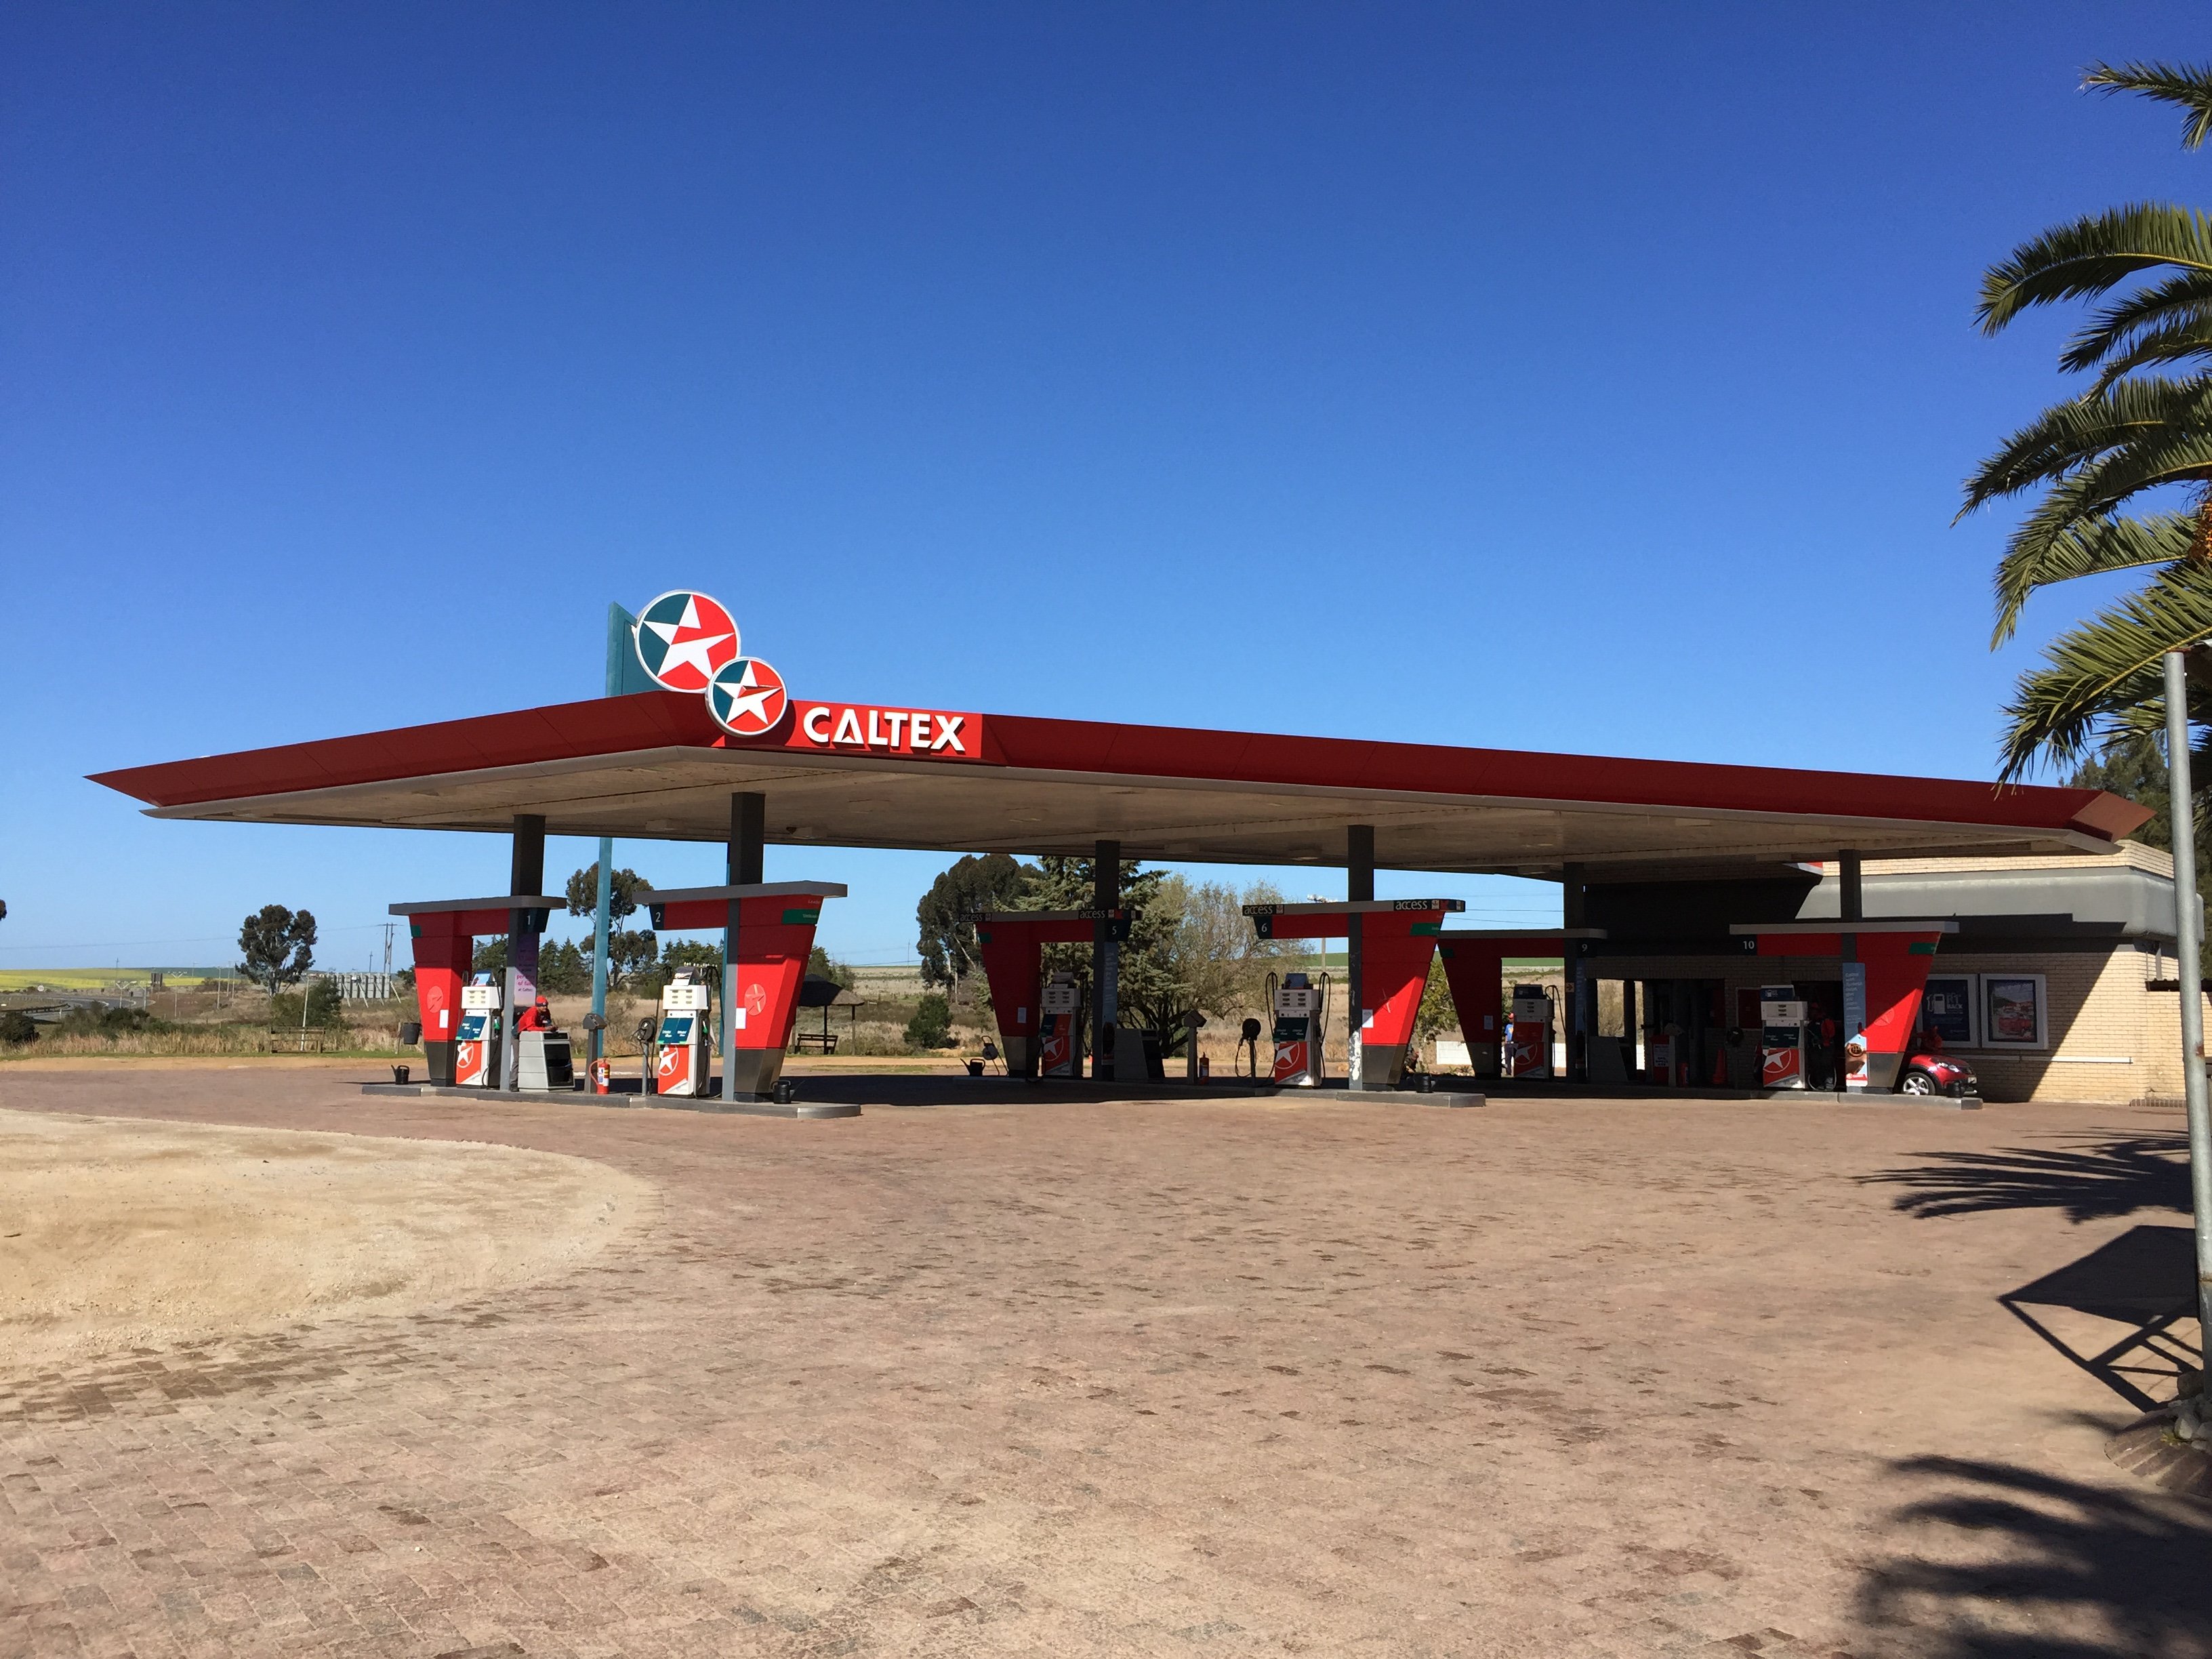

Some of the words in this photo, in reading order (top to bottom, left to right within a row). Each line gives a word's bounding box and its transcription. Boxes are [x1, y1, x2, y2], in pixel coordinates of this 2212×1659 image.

[803, 706, 966, 752] CALTEX
[1244, 905, 1273, 915] access
[1395, 900, 1428, 910] access
[655, 912, 661, 922] 2
[960, 914, 983, 922] access
[1080, 909, 1106, 919] access
[526, 915, 531, 926] 1
[1111, 926, 1118, 935] 5
[1261, 922, 1267, 933] 6
[1581, 943, 1588, 952] 9
[1742, 940, 1755, 950] 10
